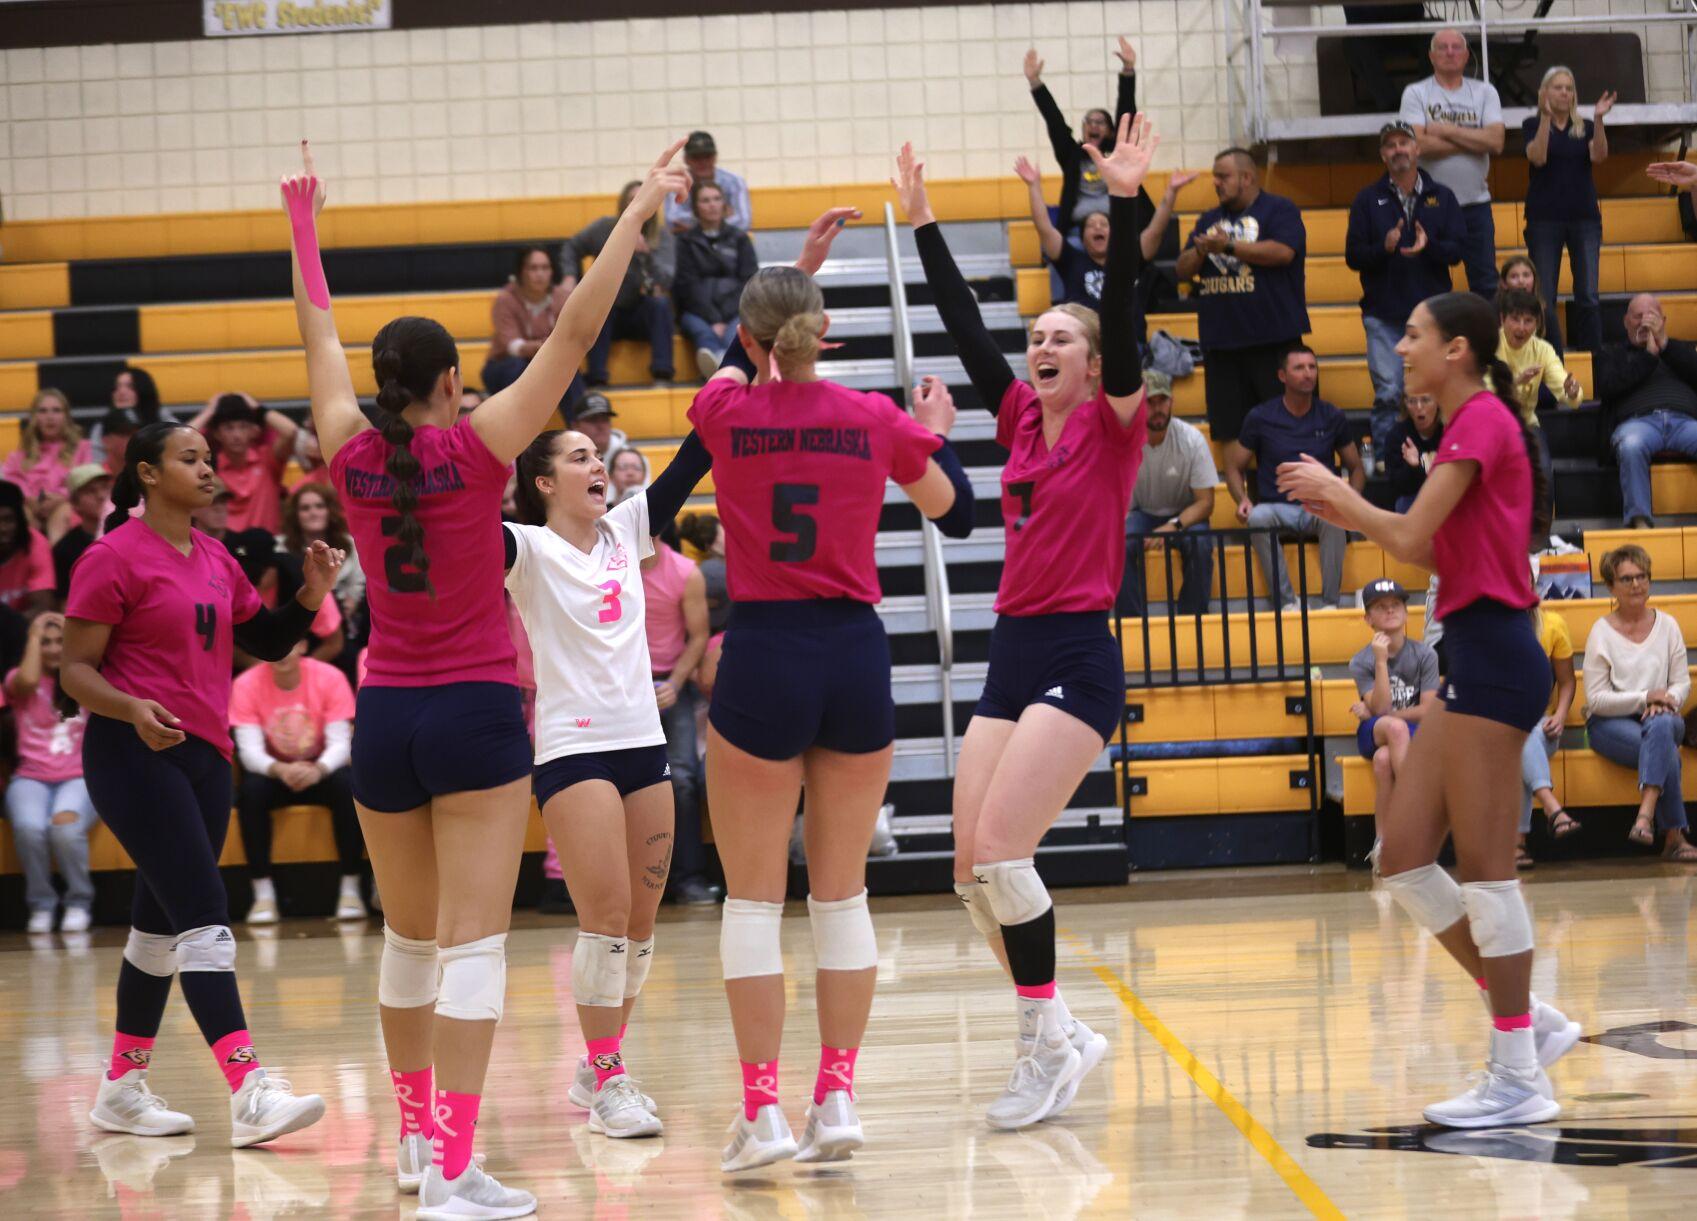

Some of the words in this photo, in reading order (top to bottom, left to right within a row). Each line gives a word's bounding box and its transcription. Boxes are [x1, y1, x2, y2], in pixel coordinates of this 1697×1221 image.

[1199, 275, 1255, 295] OUGARS
[731, 427, 795, 459] WESTERN
[800, 427, 872, 461] NEBRASKA
[769, 483, 819, 562] 5
[1007, 480, 1036, 531] 7
[381, 515, 430, 592] 2
[594, 579, 622, 624] 3
[194, 603, 216, 652] 4
